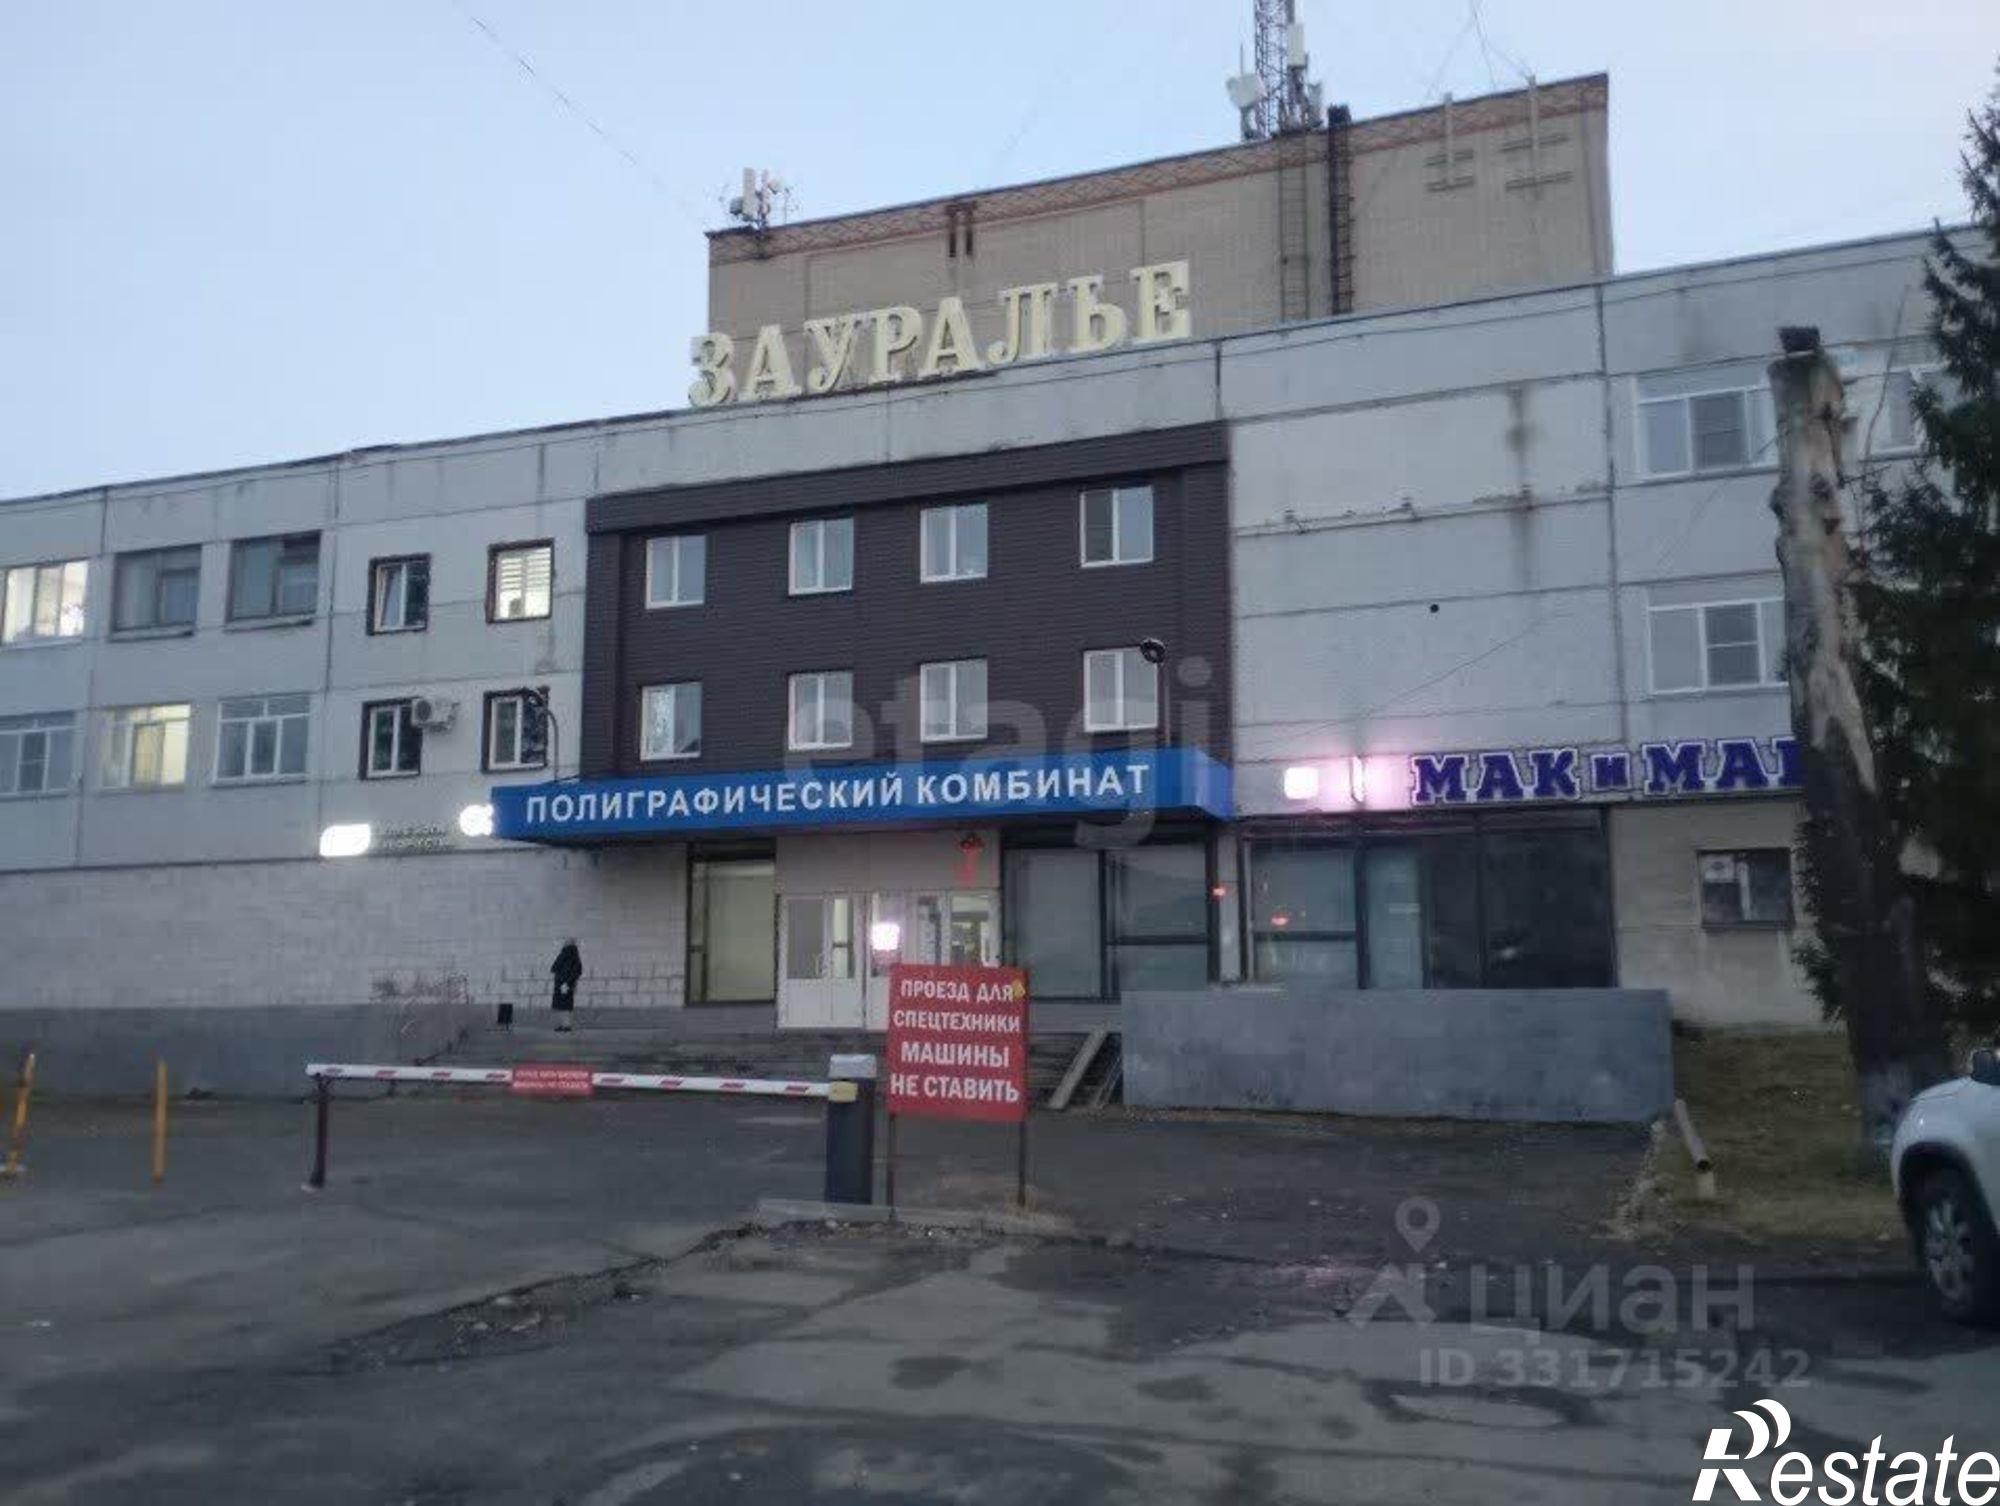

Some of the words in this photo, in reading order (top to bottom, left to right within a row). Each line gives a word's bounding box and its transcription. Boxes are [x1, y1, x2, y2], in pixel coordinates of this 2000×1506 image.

[689, 259, 1192, 407] ЗАУРАЛЬЕ
[1411, 748, 1580, 804] МАК
[526, 770, 903, 824] ПОЛИГРАФИЧЕСКИЙ
[917, 763, 1150, 806] КОМБИНАТ
[901, 979, 969, 1002] ПРОЕЗД
[976, 982, 1013, 1002] ДЛЯ
[893, 1010, 1020, 1033] СПЕЦТЕХНИКИ
[901, 1041, 1009, 1068] МАШИНЫ
[890, 1073, 919, 1096] НЕ
[924, 1076, 1019, 1103] СТАВИТЬ
